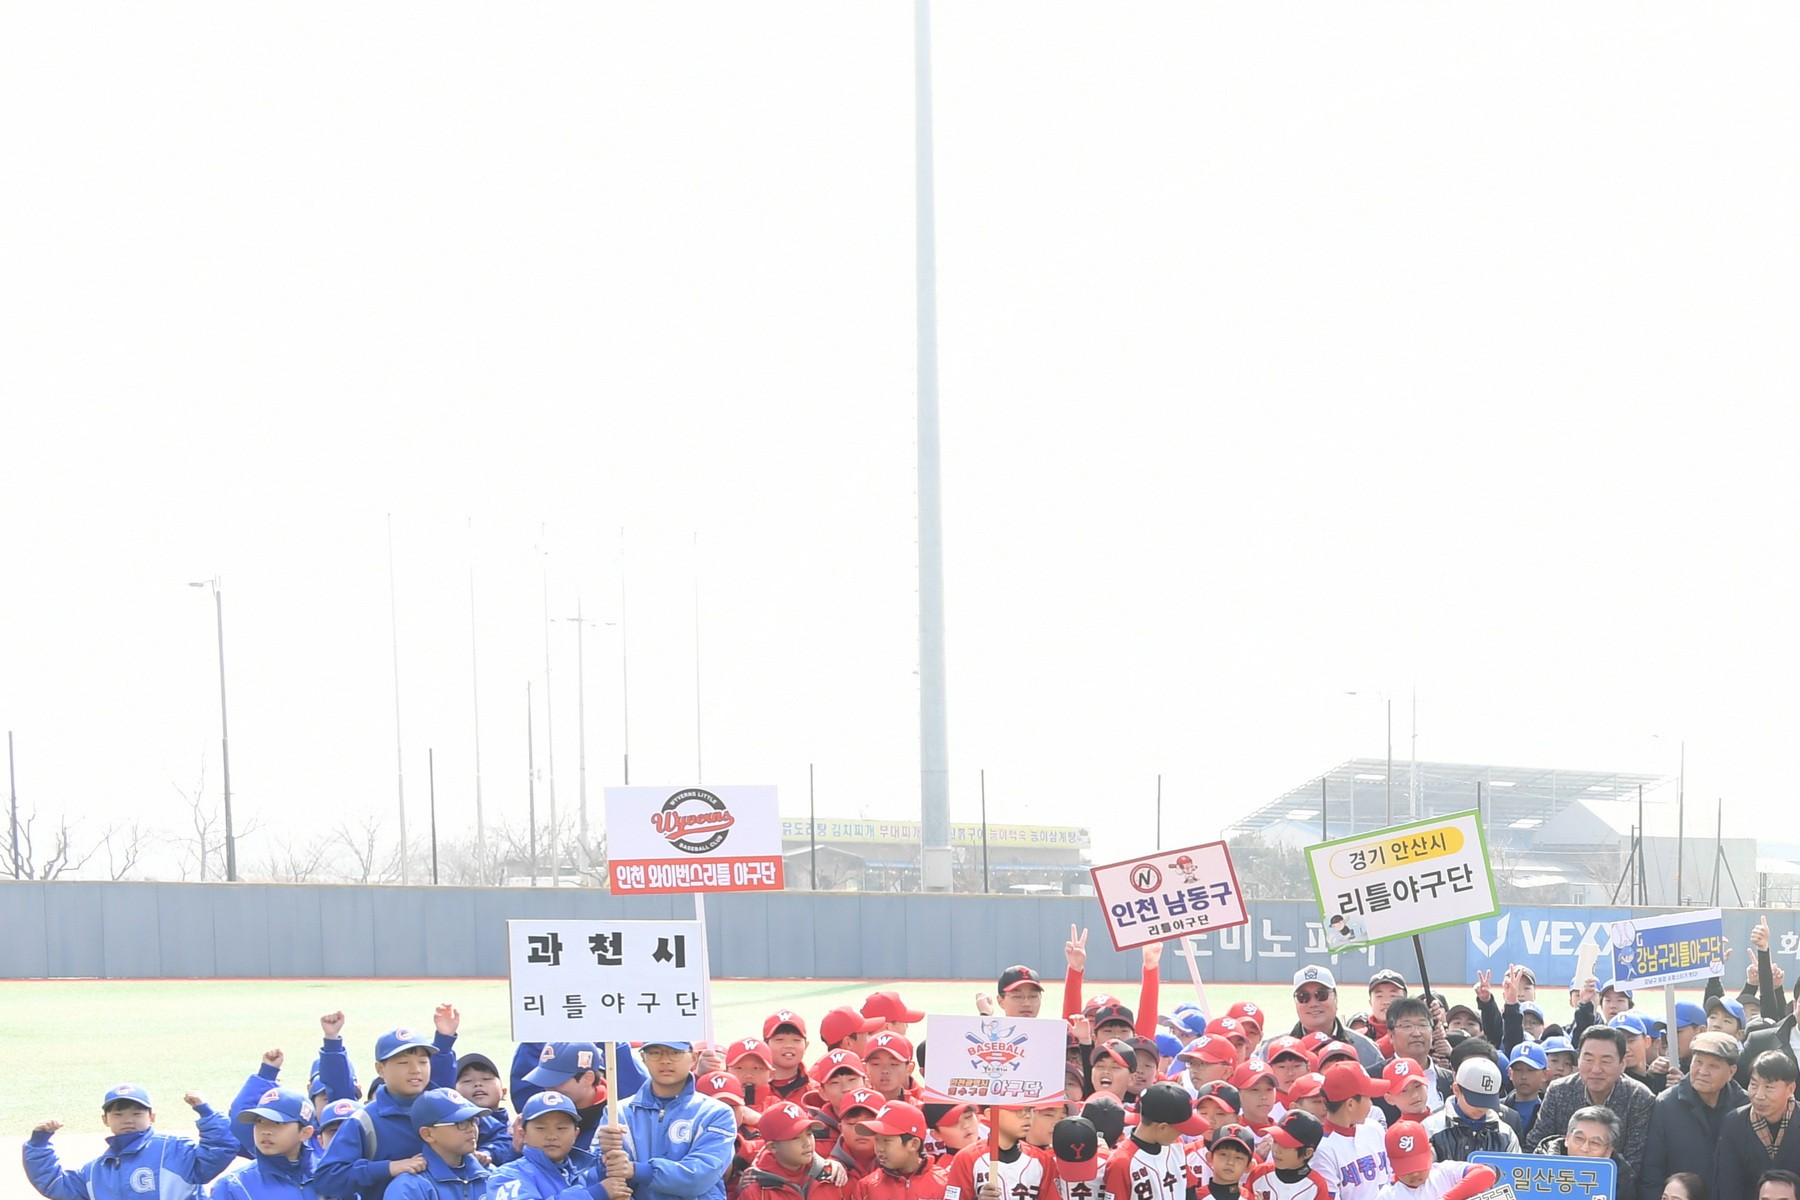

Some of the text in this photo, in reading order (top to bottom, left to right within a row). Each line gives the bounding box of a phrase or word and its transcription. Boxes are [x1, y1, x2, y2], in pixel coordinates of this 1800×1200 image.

[1349, 832, 1447, 871] 경기 안산시
[616, 862, 776, 889] 인천 와이번스리틀 야구단
[1337, 863, 1473, 916] 리틀야구단
[1112, 882, 1232, 928] 인천 남동구
[1148, 914, 1210, 936] 리틀야구단
[1636, 936, 1721, 974] 강남구리틀야구단
[523, 992, 699, 1019] 리틀야구단
[967, 1042, 1026, 1059] BASEBALL
[990, 1079, 1043, 1098] 야구단
[129, 1166, 155, 1193] G
[1512, 1166, 1599, 1194] 일산동구
